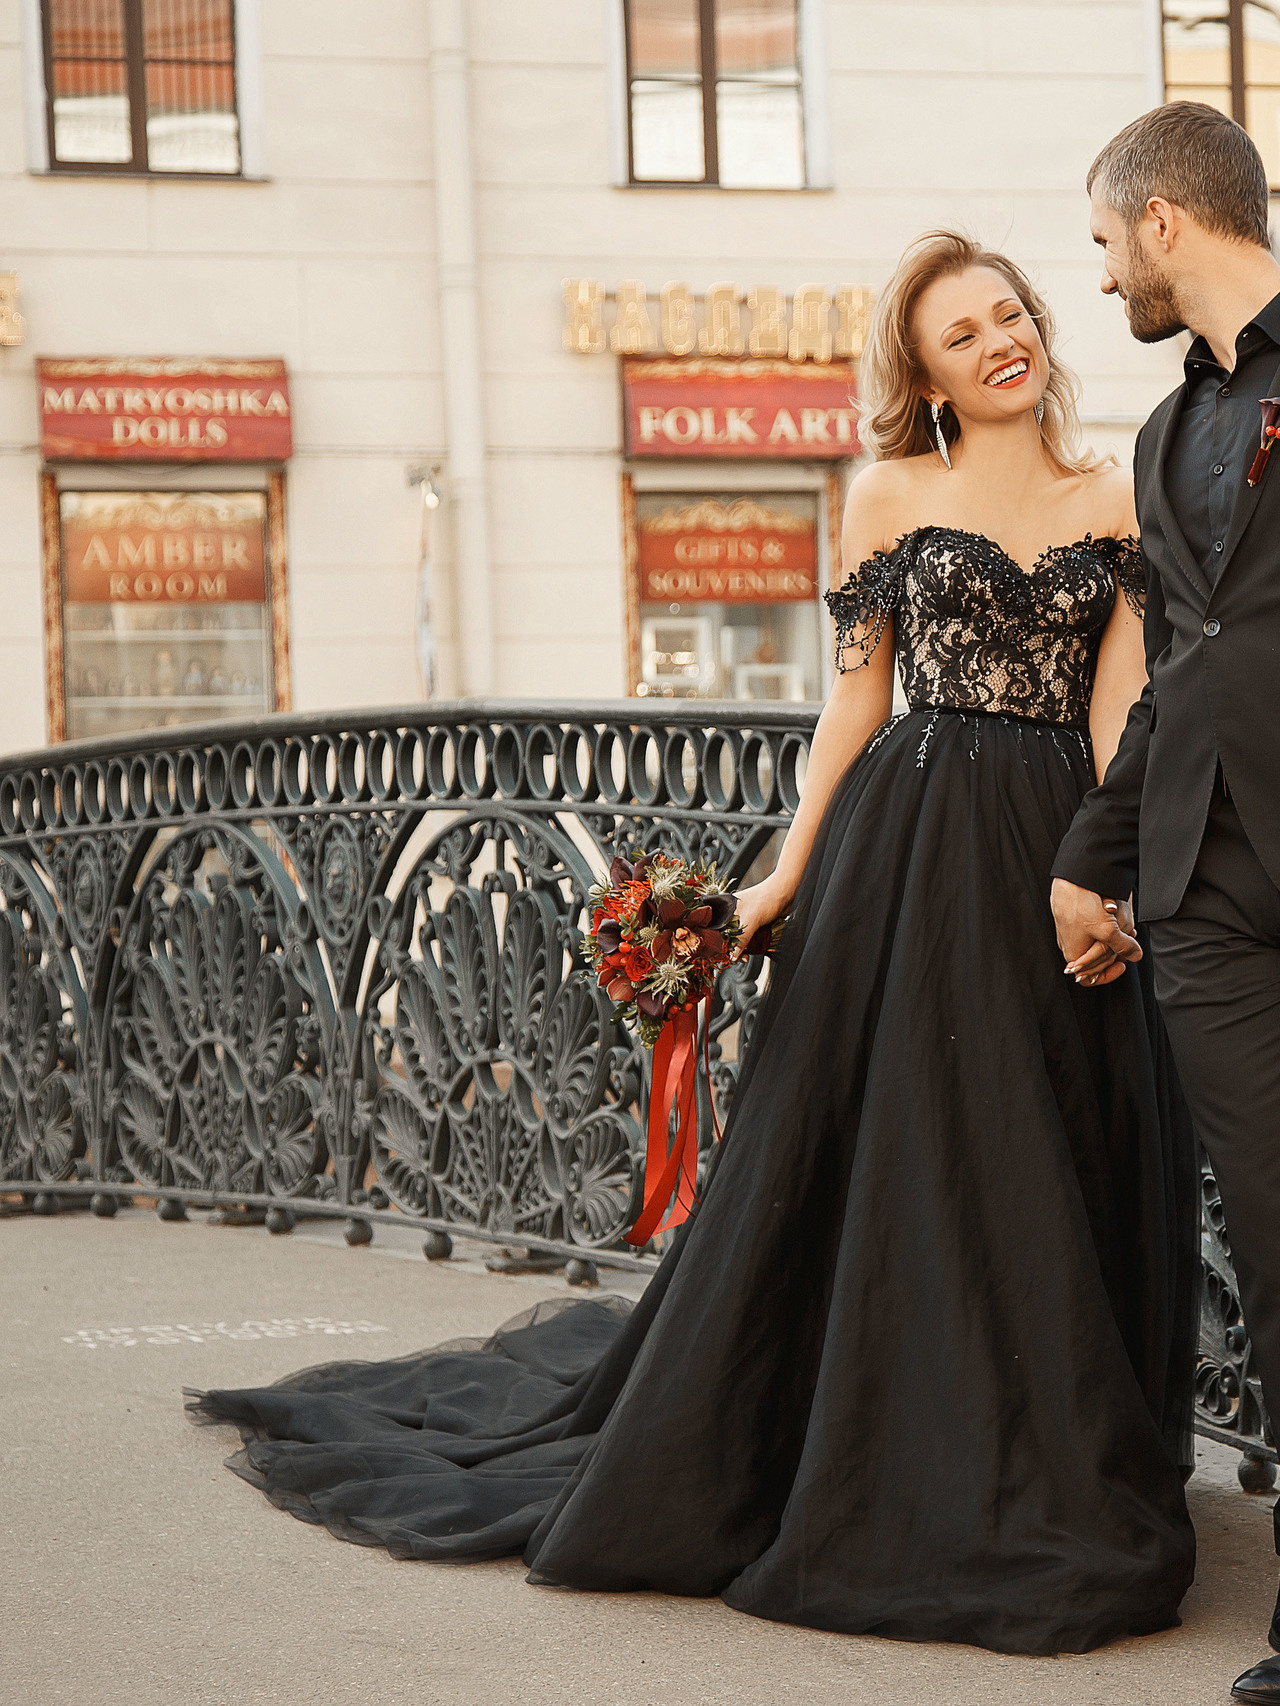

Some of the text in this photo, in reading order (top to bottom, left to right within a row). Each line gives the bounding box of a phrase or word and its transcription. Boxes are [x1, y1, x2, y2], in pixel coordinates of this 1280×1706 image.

[43, 386, 290, 417] MATRYOSHKA
[111, 416, 229, 448] DOLLS
[638, 405, 855, 446] FOLK ART
[81, 533, 251, 572] AMBER
[673, 535, 760, 567] GIFTS
[108, 571, 228, 601] ROOM
[647, 567, 813, 599] SOUVENIRS
